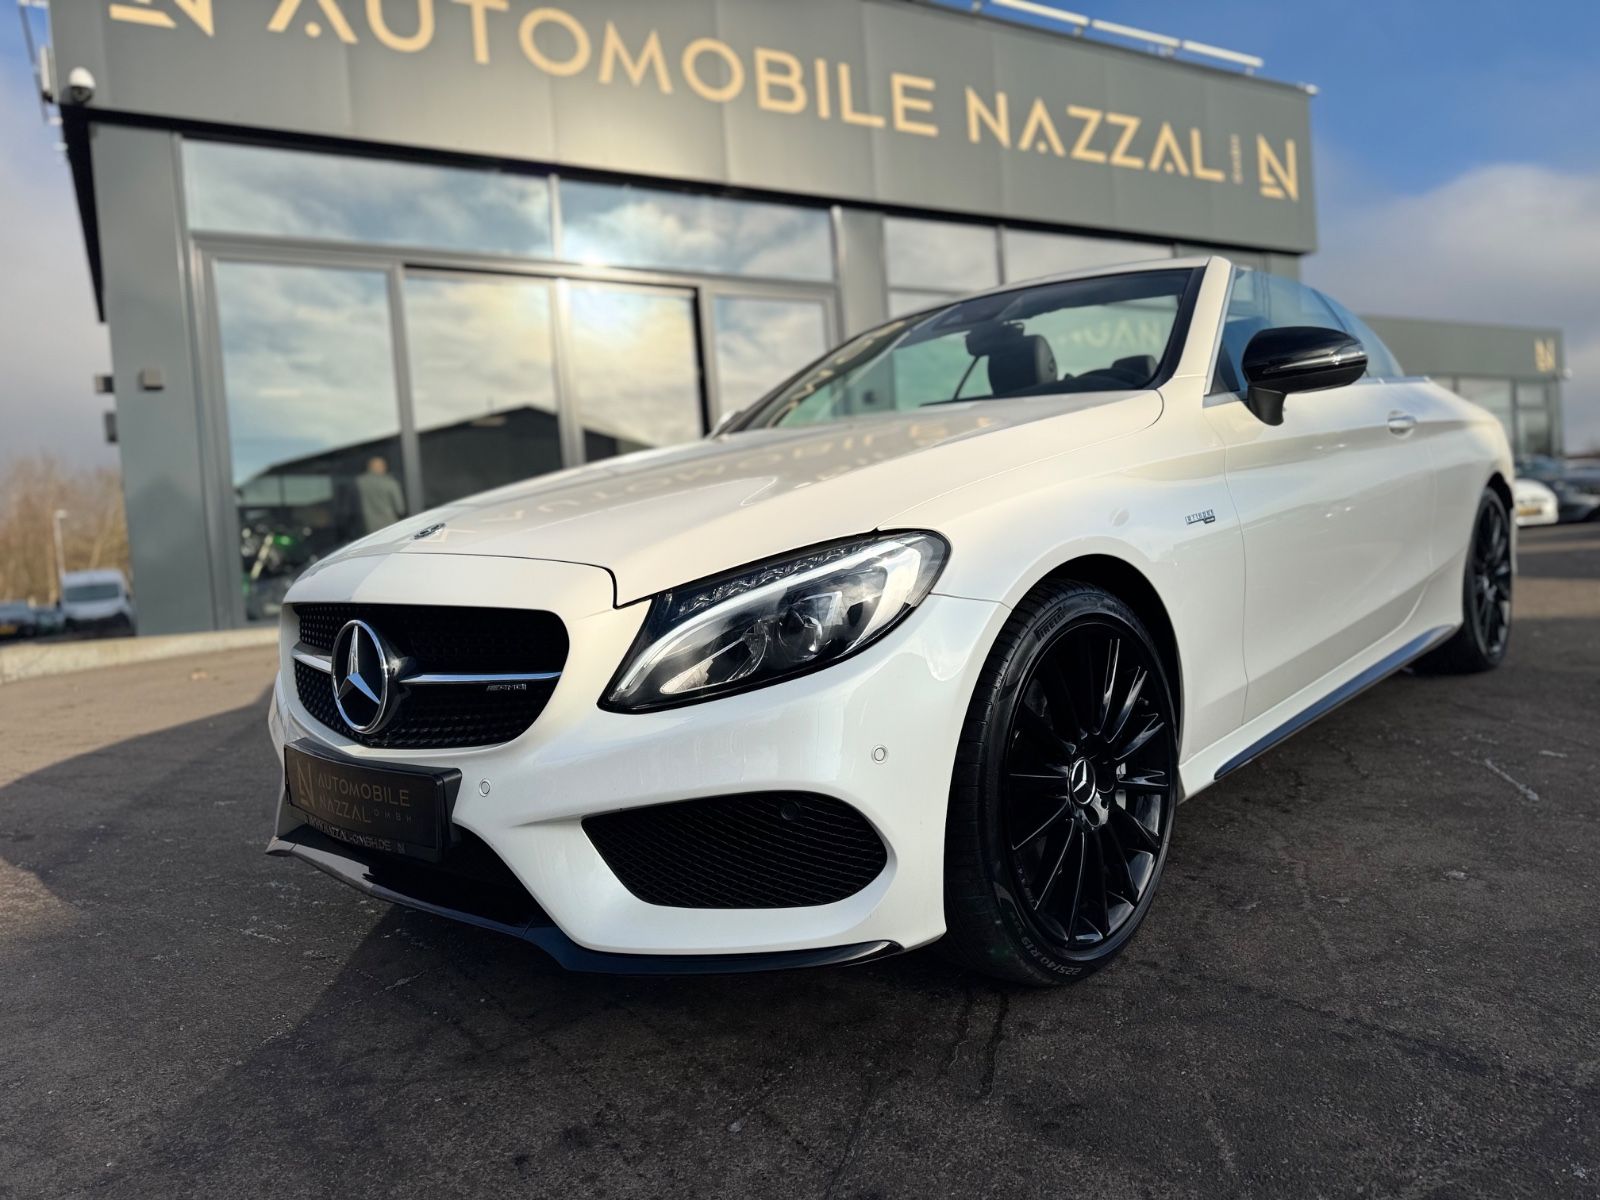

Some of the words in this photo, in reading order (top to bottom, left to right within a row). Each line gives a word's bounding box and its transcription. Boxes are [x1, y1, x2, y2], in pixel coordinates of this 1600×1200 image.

[965, 86, 1225, 182] NAZZAL
[318, 774, 411, 808] AUTOMOBILE
[319, 794, 372, 824] NAZZAL
